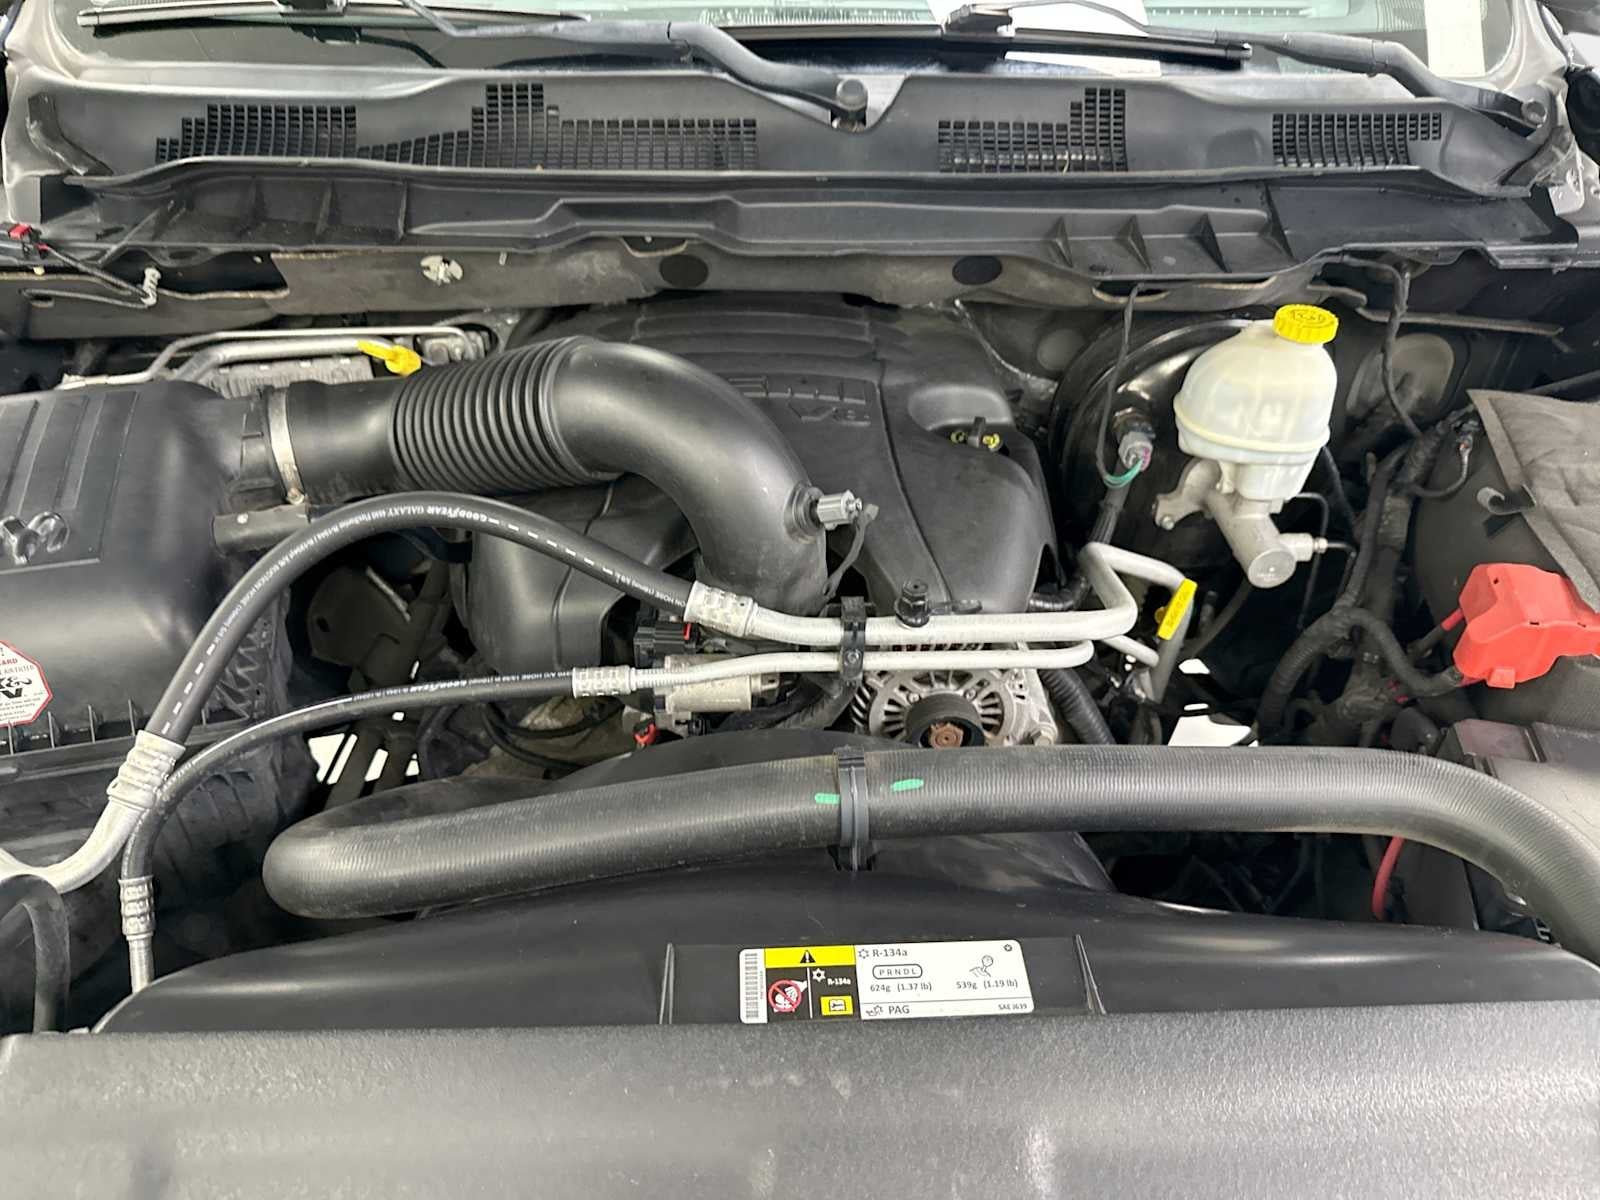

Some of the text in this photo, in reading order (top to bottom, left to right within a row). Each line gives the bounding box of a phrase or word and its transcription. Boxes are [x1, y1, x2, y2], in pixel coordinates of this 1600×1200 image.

[387, 505, 424, 516] GALAXY
[427, 504, 487, 522] GOODYEAR
[872, 948, 908, 957] R-134a
[827, 978, 851, 986] R-134a
[870, 981, 932, 992] 624g (1.37 lb)
[956, 979, 1018, 990] 539g (1.19 lb)
[888, 1005, 910, 1015] PAG
